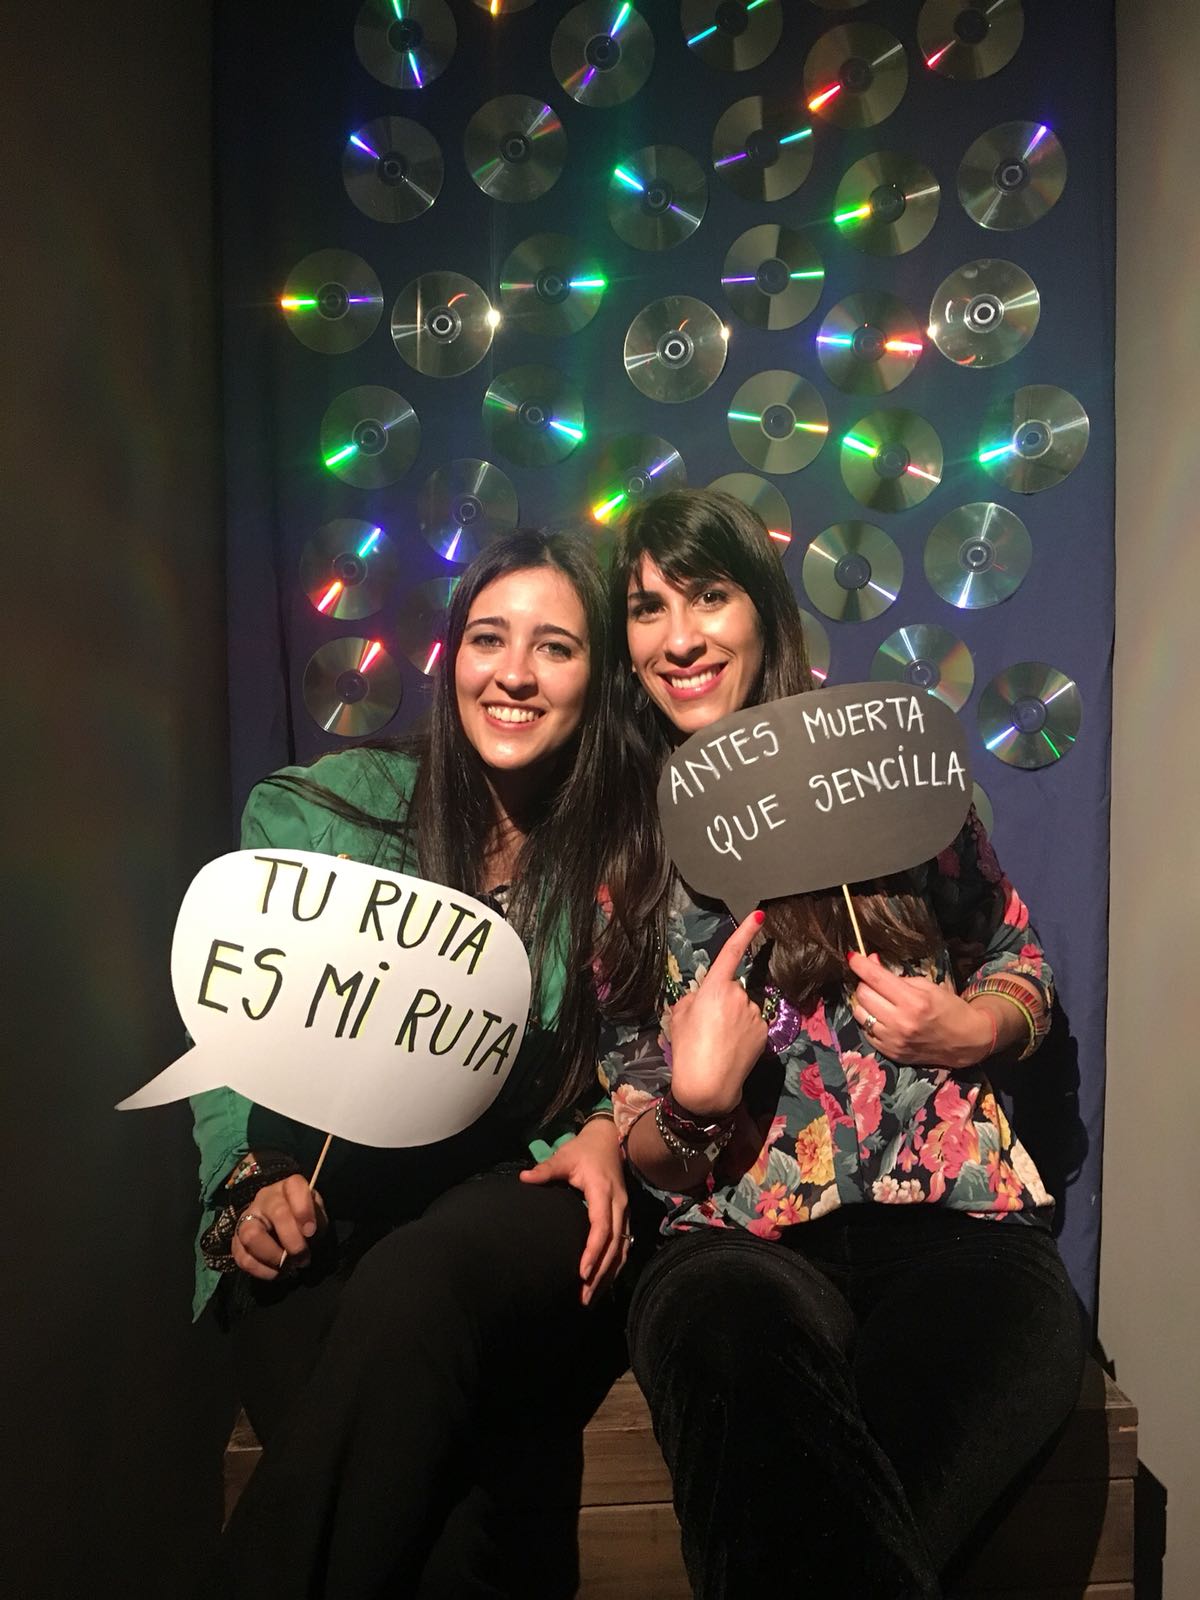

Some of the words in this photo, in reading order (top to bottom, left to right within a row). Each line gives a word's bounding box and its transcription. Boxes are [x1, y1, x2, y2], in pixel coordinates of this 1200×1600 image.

[670, 721, 780, 804] ANTES
[802, 696, 925, 743] MUERTA
[706, 793, 786, 861] QUE
[254, 855, 337, 922] TU
[359, 879, 492, 975] RUTA
[197, 938, 287, 1020] ES
[395, 988, 519, 1075] RUTA
